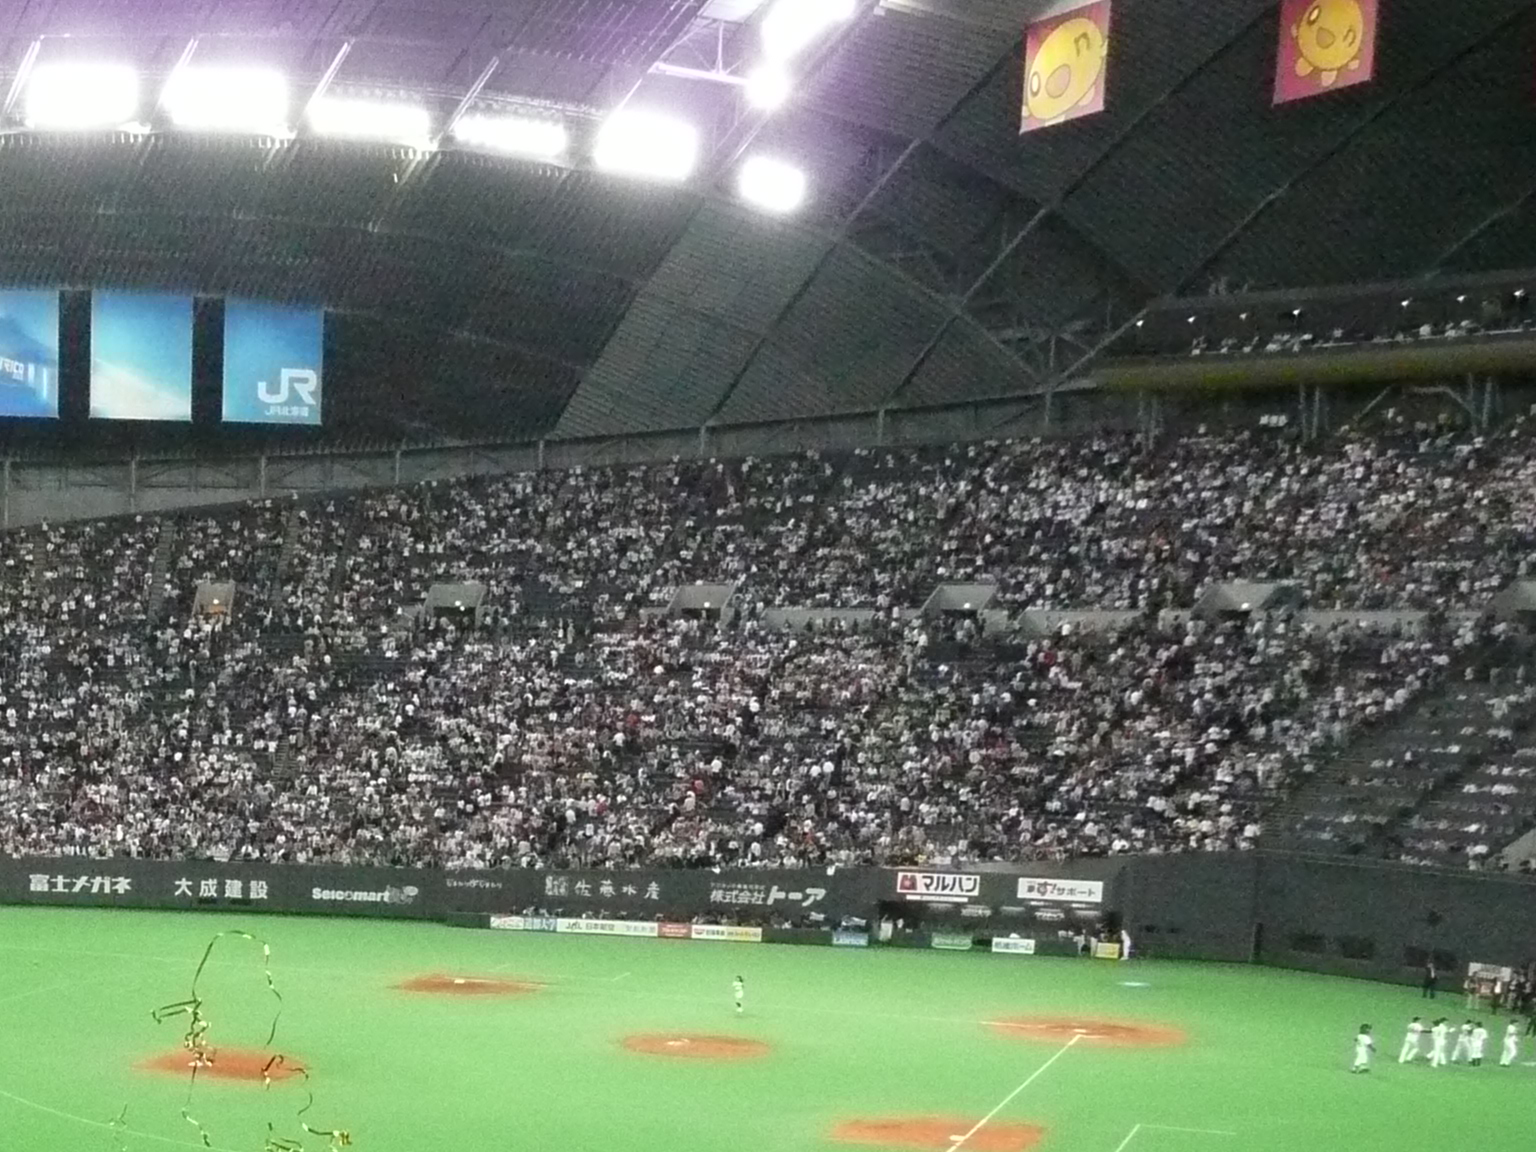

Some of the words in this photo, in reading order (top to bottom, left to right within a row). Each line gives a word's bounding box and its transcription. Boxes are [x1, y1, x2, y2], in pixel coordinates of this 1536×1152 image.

[257, 367, 317, 405] JR
[29, 874, 133, 896] 富士メガネ
[174, 877, 270, 900] 大成建設
[311, 886, 390, 903] Seicomart
[921, 875, 978, 894] マルハン
[766, 885, 827, 907] トーア
